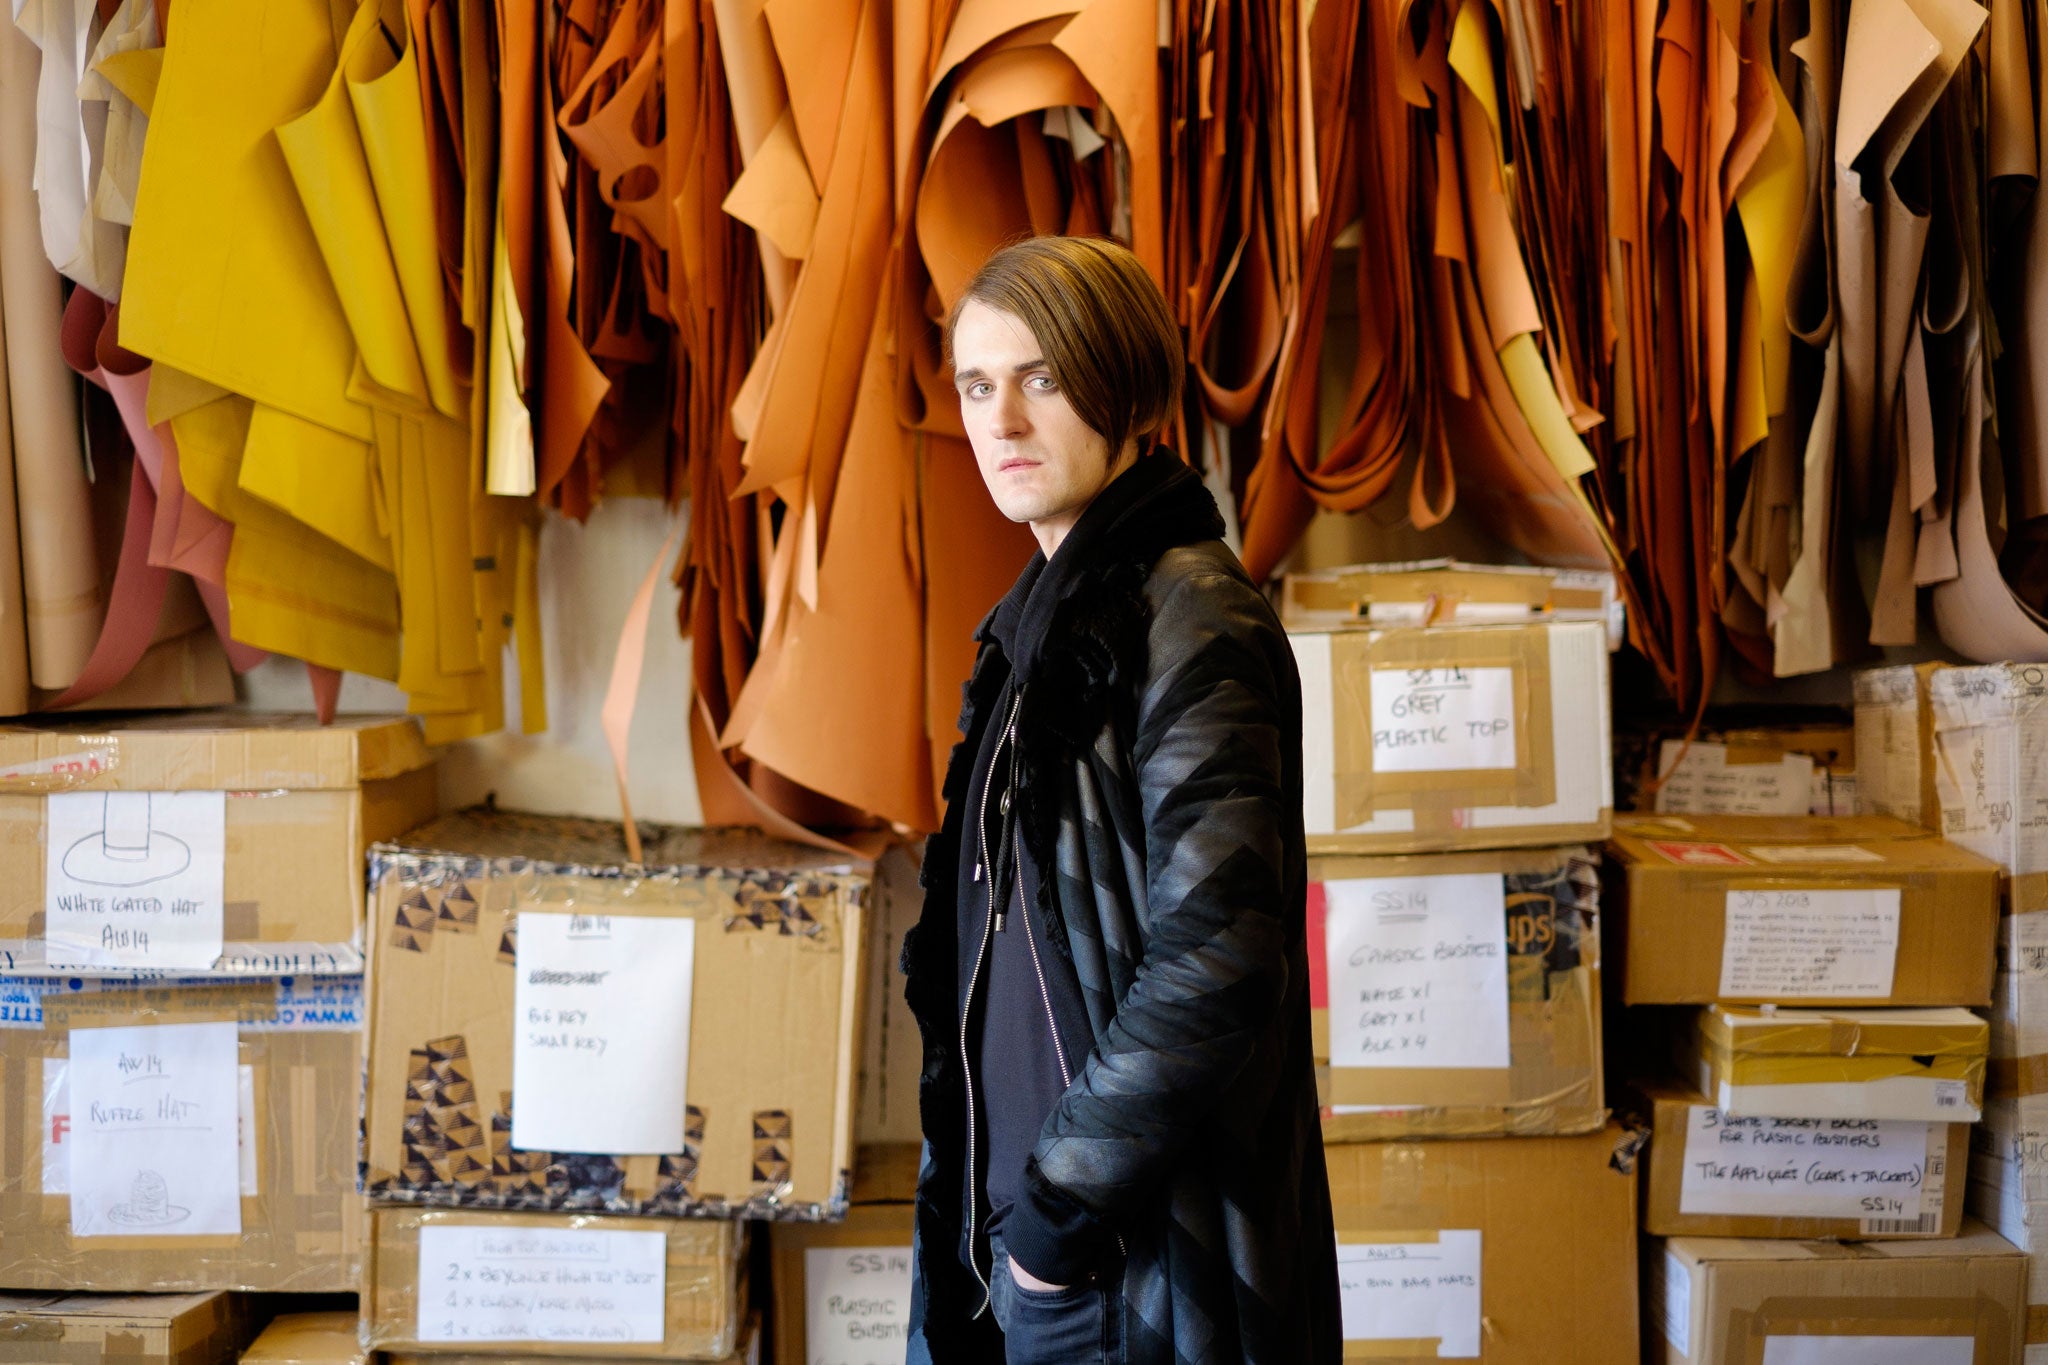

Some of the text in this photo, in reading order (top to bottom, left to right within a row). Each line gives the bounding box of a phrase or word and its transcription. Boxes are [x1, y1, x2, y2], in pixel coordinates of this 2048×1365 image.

[1391, 693, 1446, 718] GREY
[1373, 718, 1509, 749] PLASTIC TOP
[171, 898, 204, 916] HAT
[157, 1093, 201, 1121] HAT
